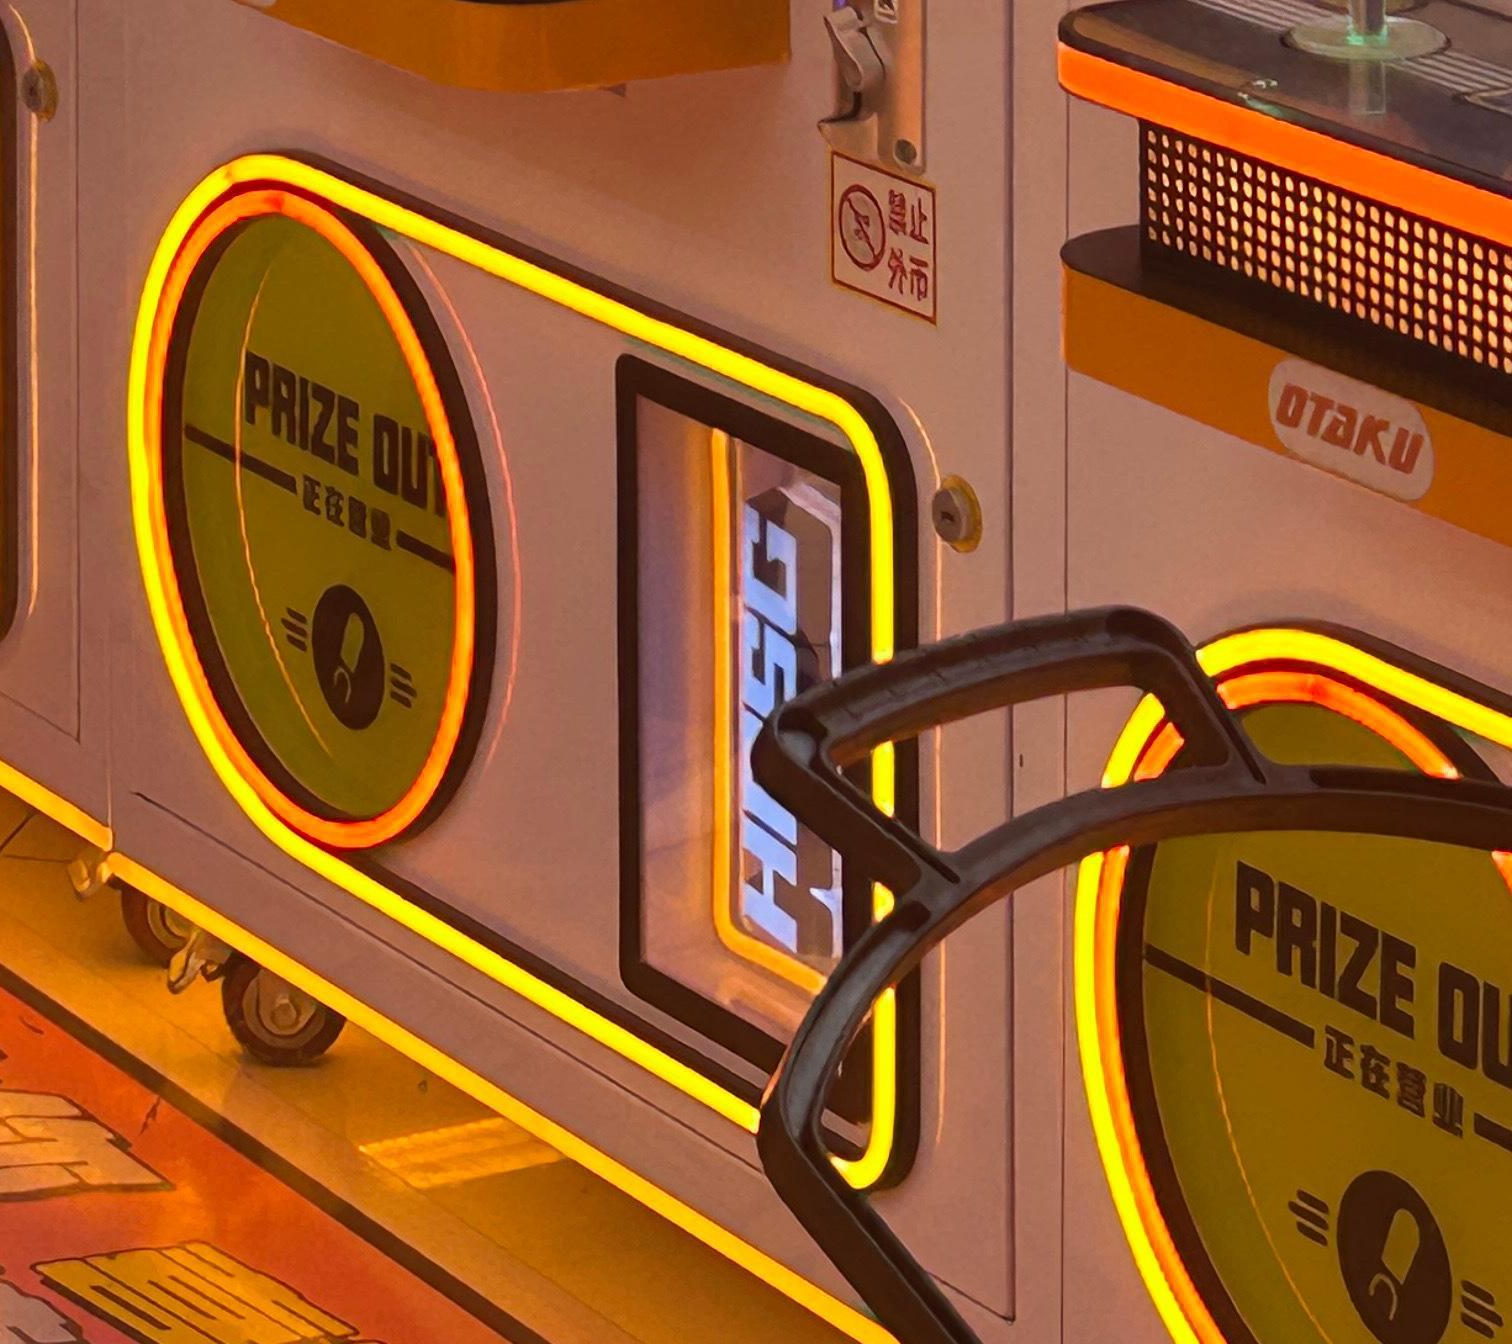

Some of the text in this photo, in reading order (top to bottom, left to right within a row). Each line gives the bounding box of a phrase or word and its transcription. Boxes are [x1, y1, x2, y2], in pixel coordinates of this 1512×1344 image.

[243, 351, 359, 476] PRIZE
[1234, 858, 1512, 1096] PRIZE OU
[1324, 1024, 1465, 1139] 正在营业
